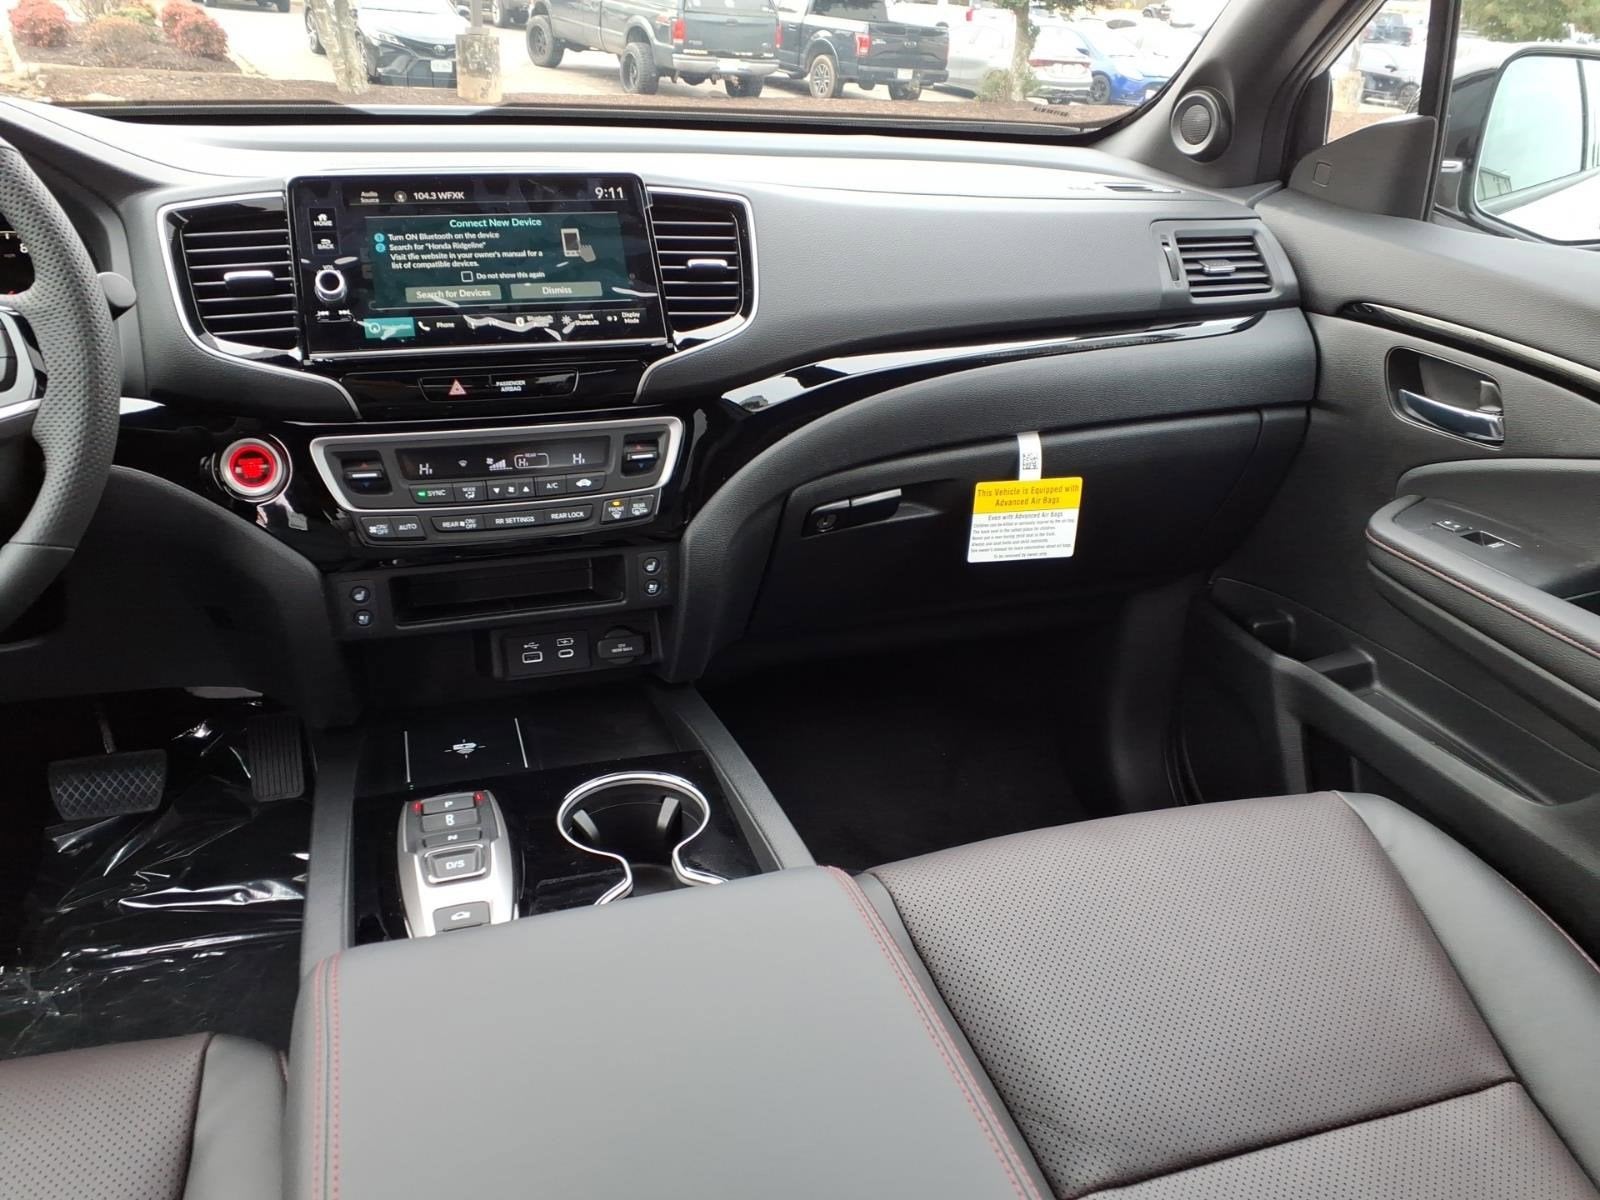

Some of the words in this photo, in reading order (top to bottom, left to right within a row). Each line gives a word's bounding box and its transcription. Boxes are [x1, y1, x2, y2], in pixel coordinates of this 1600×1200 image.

[413, 191, 436, 200] 104.3
[437, 191, 465, 200] WFXK
[595, 186, 623, 199] 9:11
[449, 219, 487, 228] Connect
[488, 218, 510, 227] New
[511, 217, 542, 227] Device
[387, 233, 404, 241] Turn
[405, 233, 418, 241] ON
[419, 232, 453, 240] Bluetooth
[477, 231, 500, 239] device
[389, 243, 413, 251] Search
[407, 252, 420, 260] the
[421, 252, 448, 260] website
[457, 252, 473, 260] your
[403, 261, 412, 269] of
[412, 261, 451, 270] compatible
[476, 272, 487, 280] Do
[499, 271, 516, 279] show
[516, 271, 529, 279] this
[416, 289, 444, 299] Search
[445, 289, 457, 298] for
[459, 288, 491, 298] Devices
[542, 285, 572, 295] Dismiss
[426, 489, 446, 497] SYNC
[994, 488, 1021, 497] Vehicle
[1022, 487, 1029, 495] is
[1031, 485, 1063, 496] Equipped
[1065, 484, 1080, 493] with
[995, 497, 1029, 507] Advanced
[1031, 496, 1042, 505] Air
[1043, 496, 1060, 505] Bags
[567, 511, 584, 519] LOCK
[505, 516, 535, 524] SETTINGS
